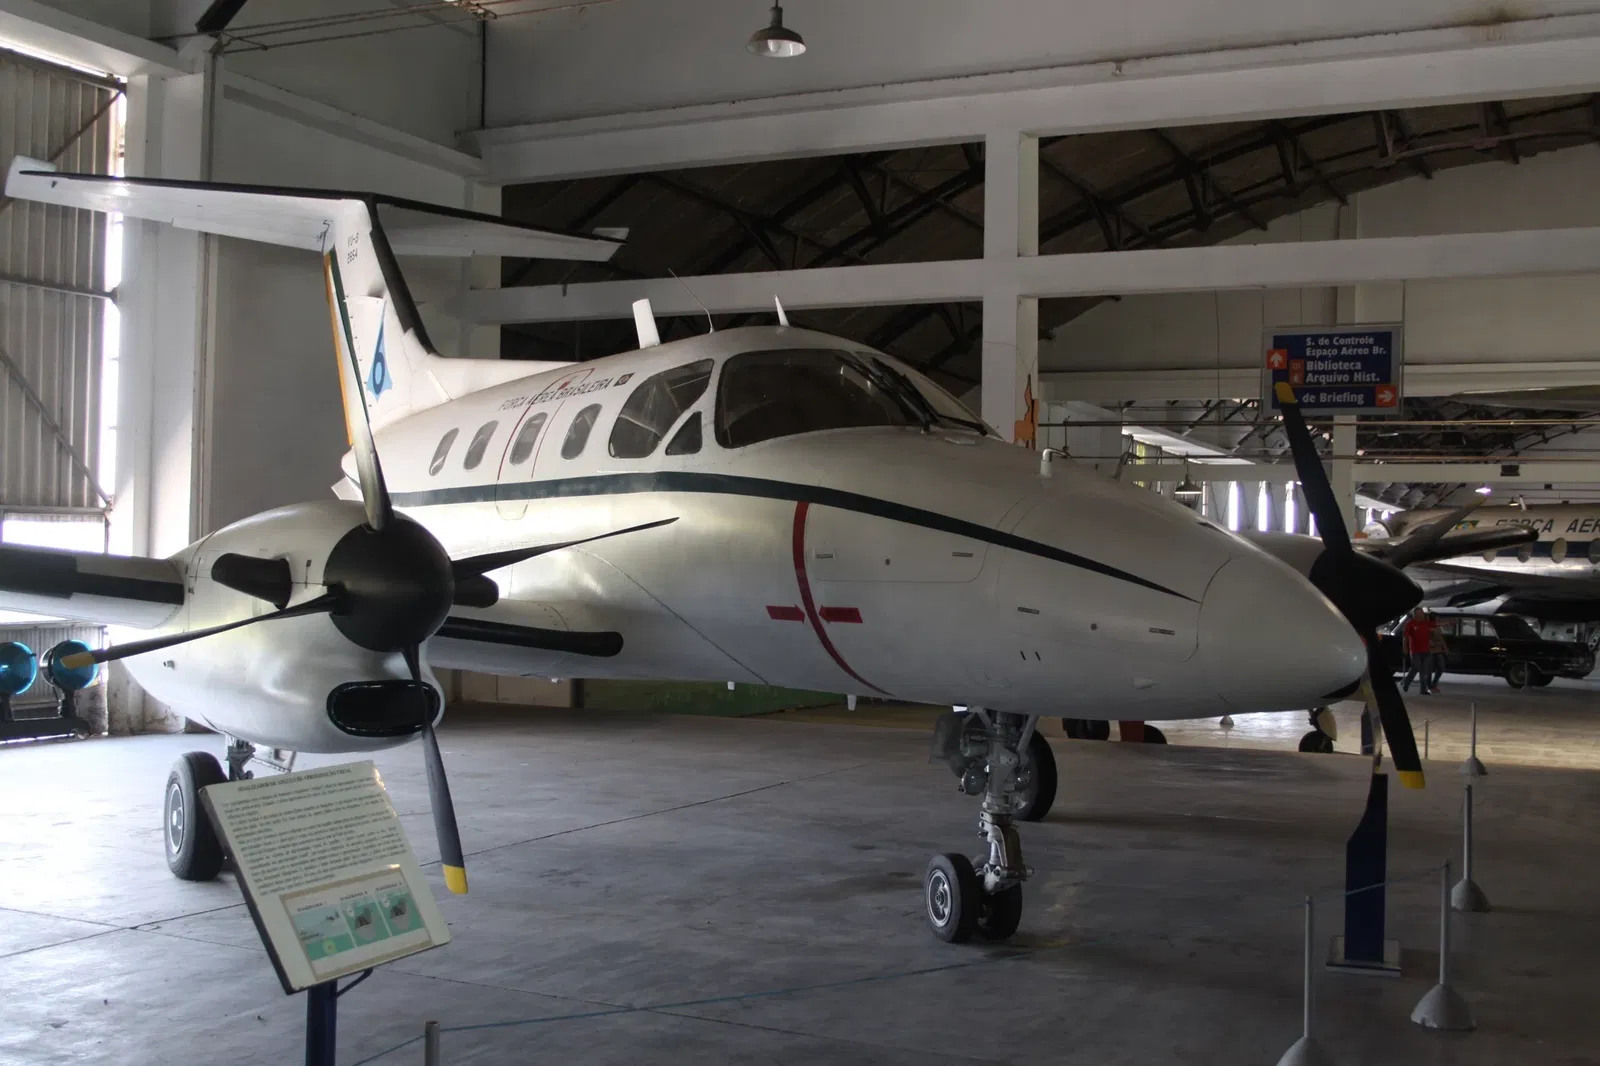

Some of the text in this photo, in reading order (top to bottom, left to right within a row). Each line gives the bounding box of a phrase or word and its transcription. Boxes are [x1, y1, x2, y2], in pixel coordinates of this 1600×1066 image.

[1306, 336, 1374, 346] S. de Controle
[1306, 346, 1386, 358] Espaço Aéreo Br.
[1306, 360, 1362, 370] Biblioteca
[1306, 372, 1380, 384] Arquivo Hist.
[1302, 393, 1316, 403] de
[1320, 392, 1364, 404] Briefing
